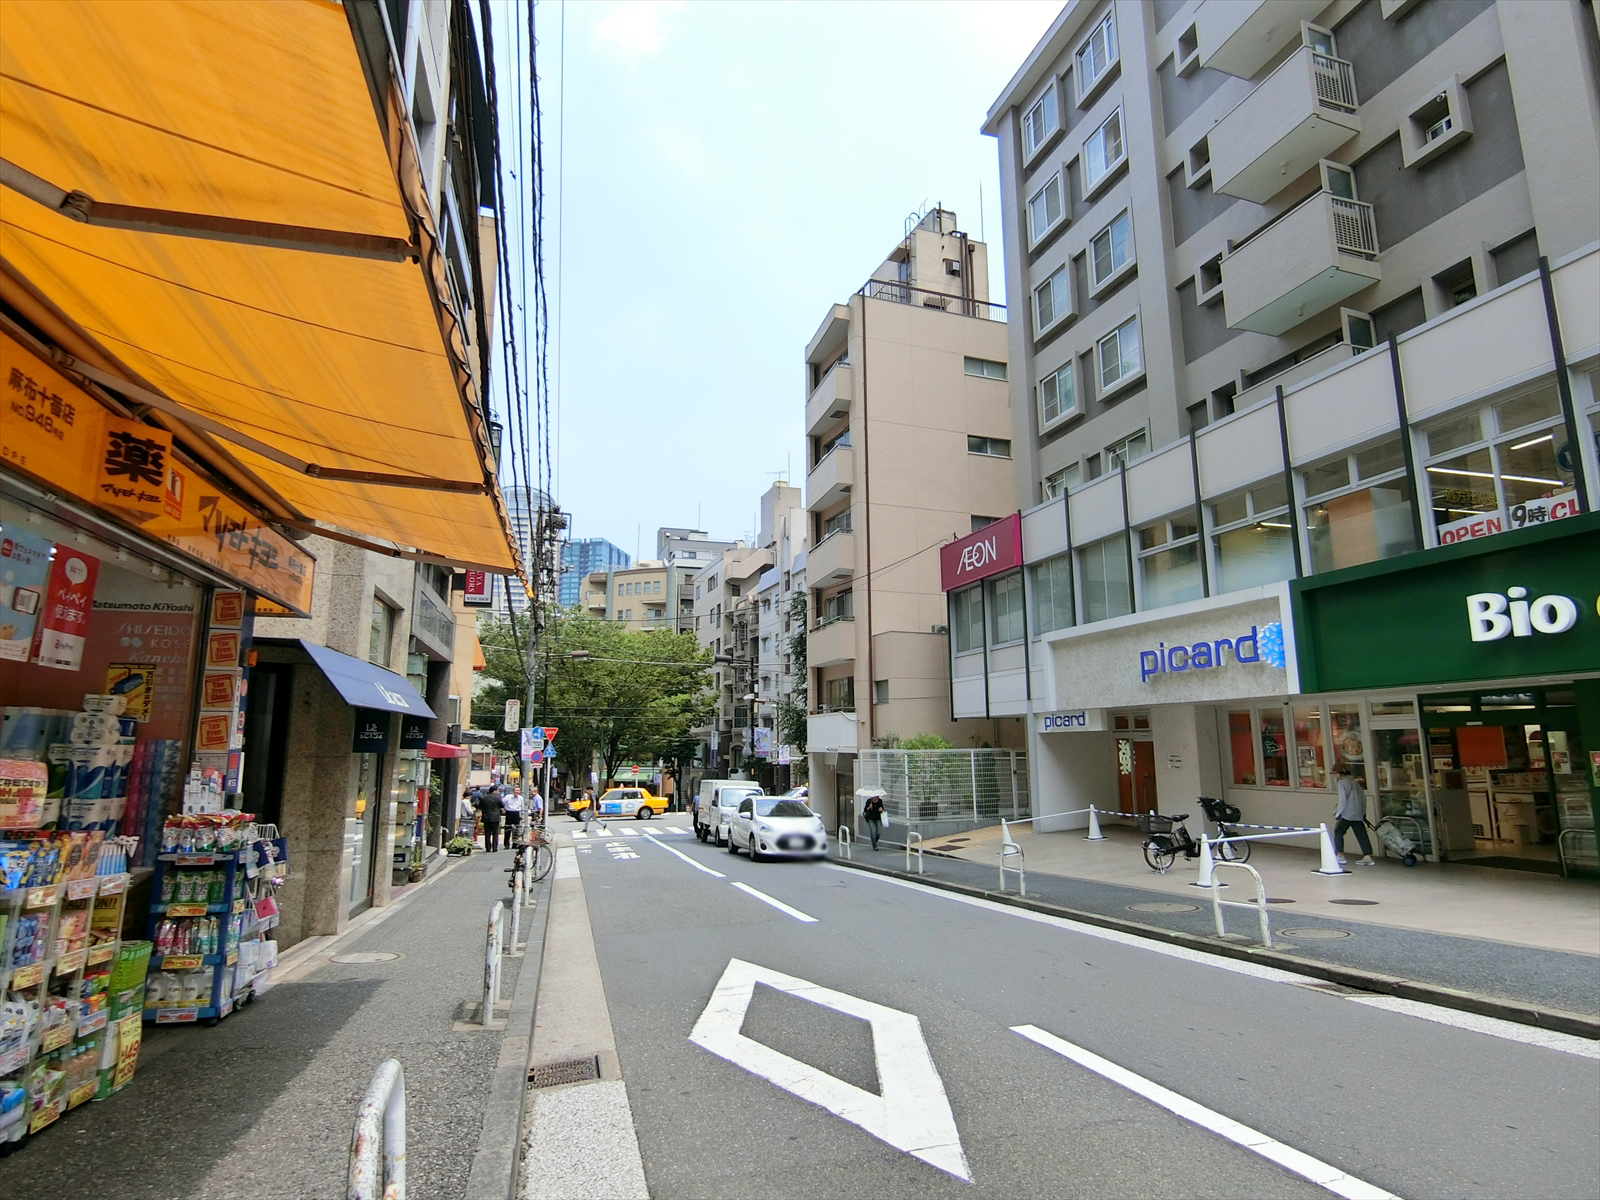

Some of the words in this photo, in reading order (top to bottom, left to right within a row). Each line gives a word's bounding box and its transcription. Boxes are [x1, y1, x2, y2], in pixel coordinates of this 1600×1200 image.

[9, 366, 76, 427] 麻布十番店
[105, 431, 166, 487] 薬
[101, 484, 162, 502] マツモトキヨシ
[1511, 505, 1547, 527] 9時
[198, 496, 278, 570] マツモトキヨシ
[1442, 517, 1502, 545] OPEN
[58, 588, 88, 607] ペイペイ
[152, 602, 194, 611] KiYoshi
[1466, 586, 1578, 642] Bio
[117, 622, 191, 635] SHISEIDO
[1140, 626, 1260, 682] picard
[1044, 711, 1085, 731] picard
